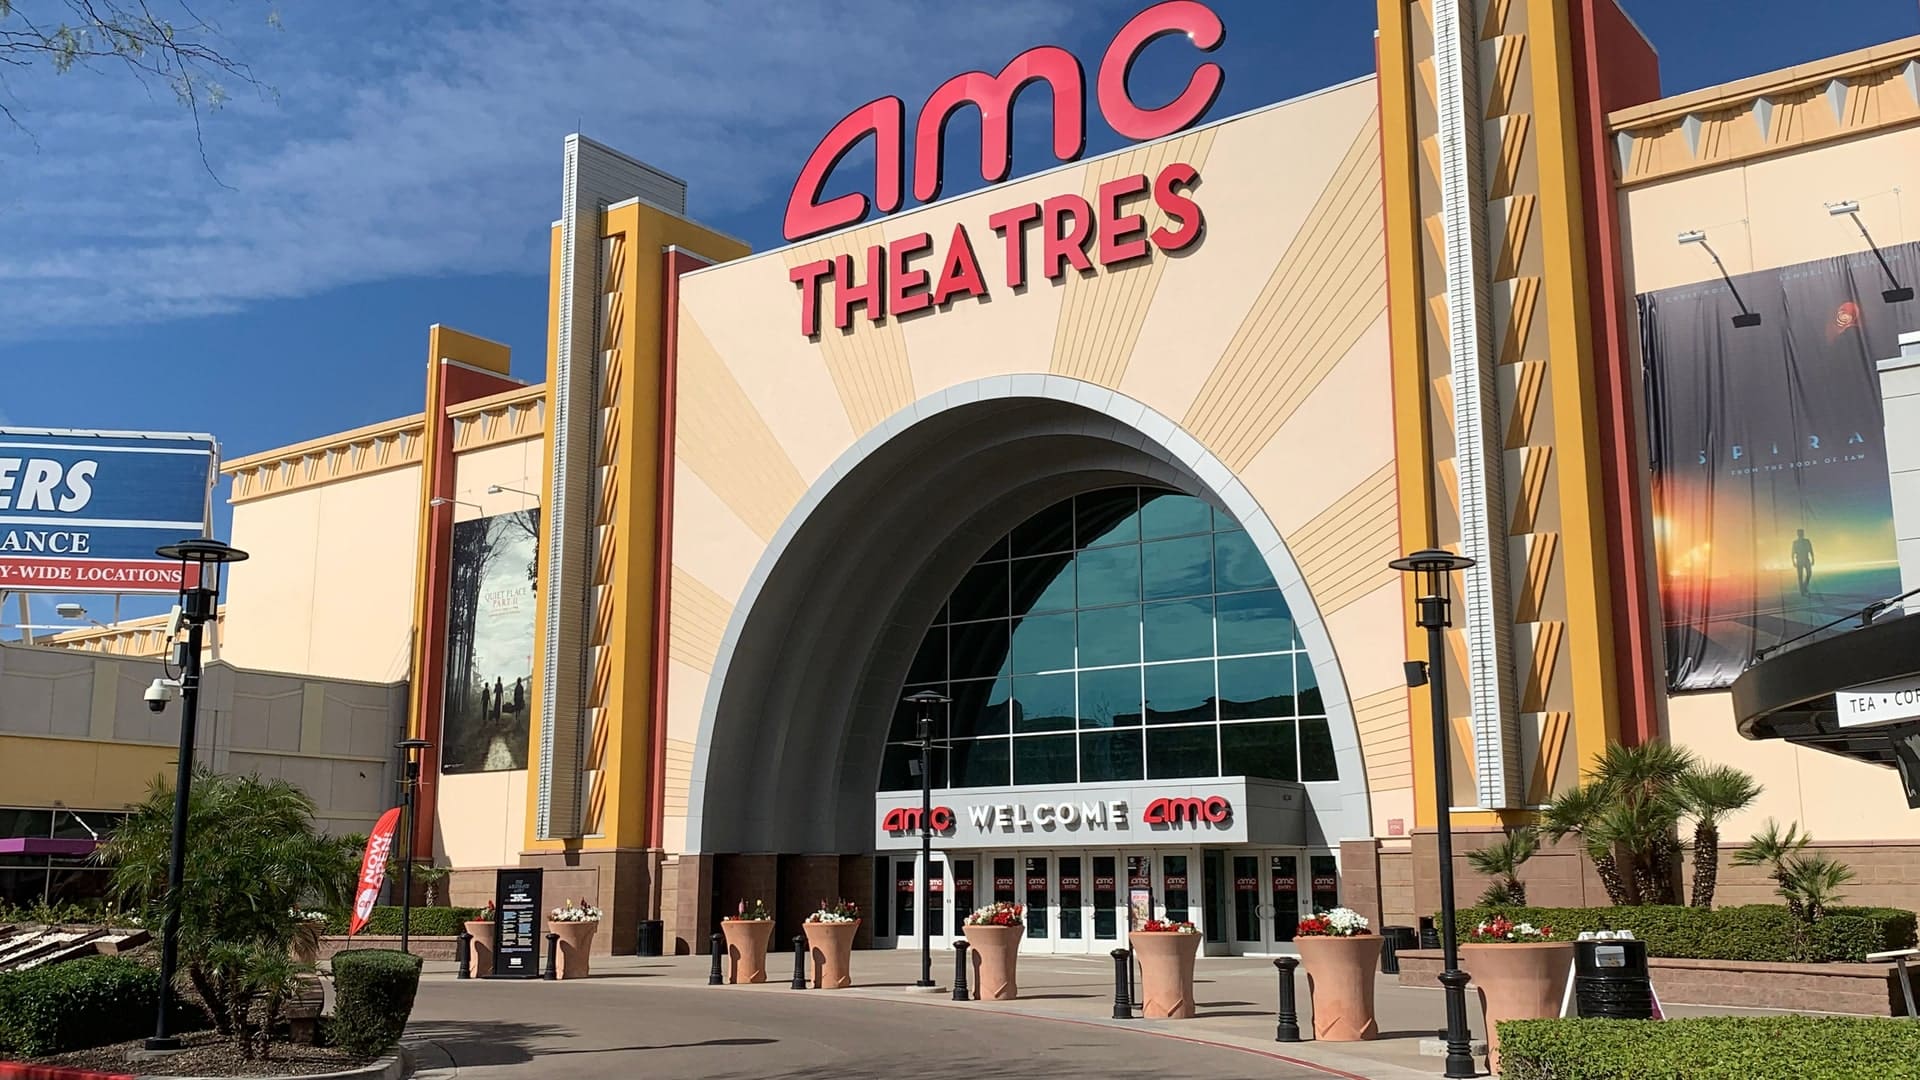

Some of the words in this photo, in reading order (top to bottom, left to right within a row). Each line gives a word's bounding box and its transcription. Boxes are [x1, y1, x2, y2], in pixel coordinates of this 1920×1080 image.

[789, 162, 1205, 337] THEATRES
[1765, 464, 1783, 472] THE
[0, 458, 98, 512] ERS
[0, 531, 90, 553] ANCE
[0, 565, 71, 580] Y-WIDE
[77, 567, 182, 583] LOCATIONS
[1850, 696, 1876, 713] TEA
[967, 799, 1127, 827] WELCOME
[364, 833, 382, 884] NOW
